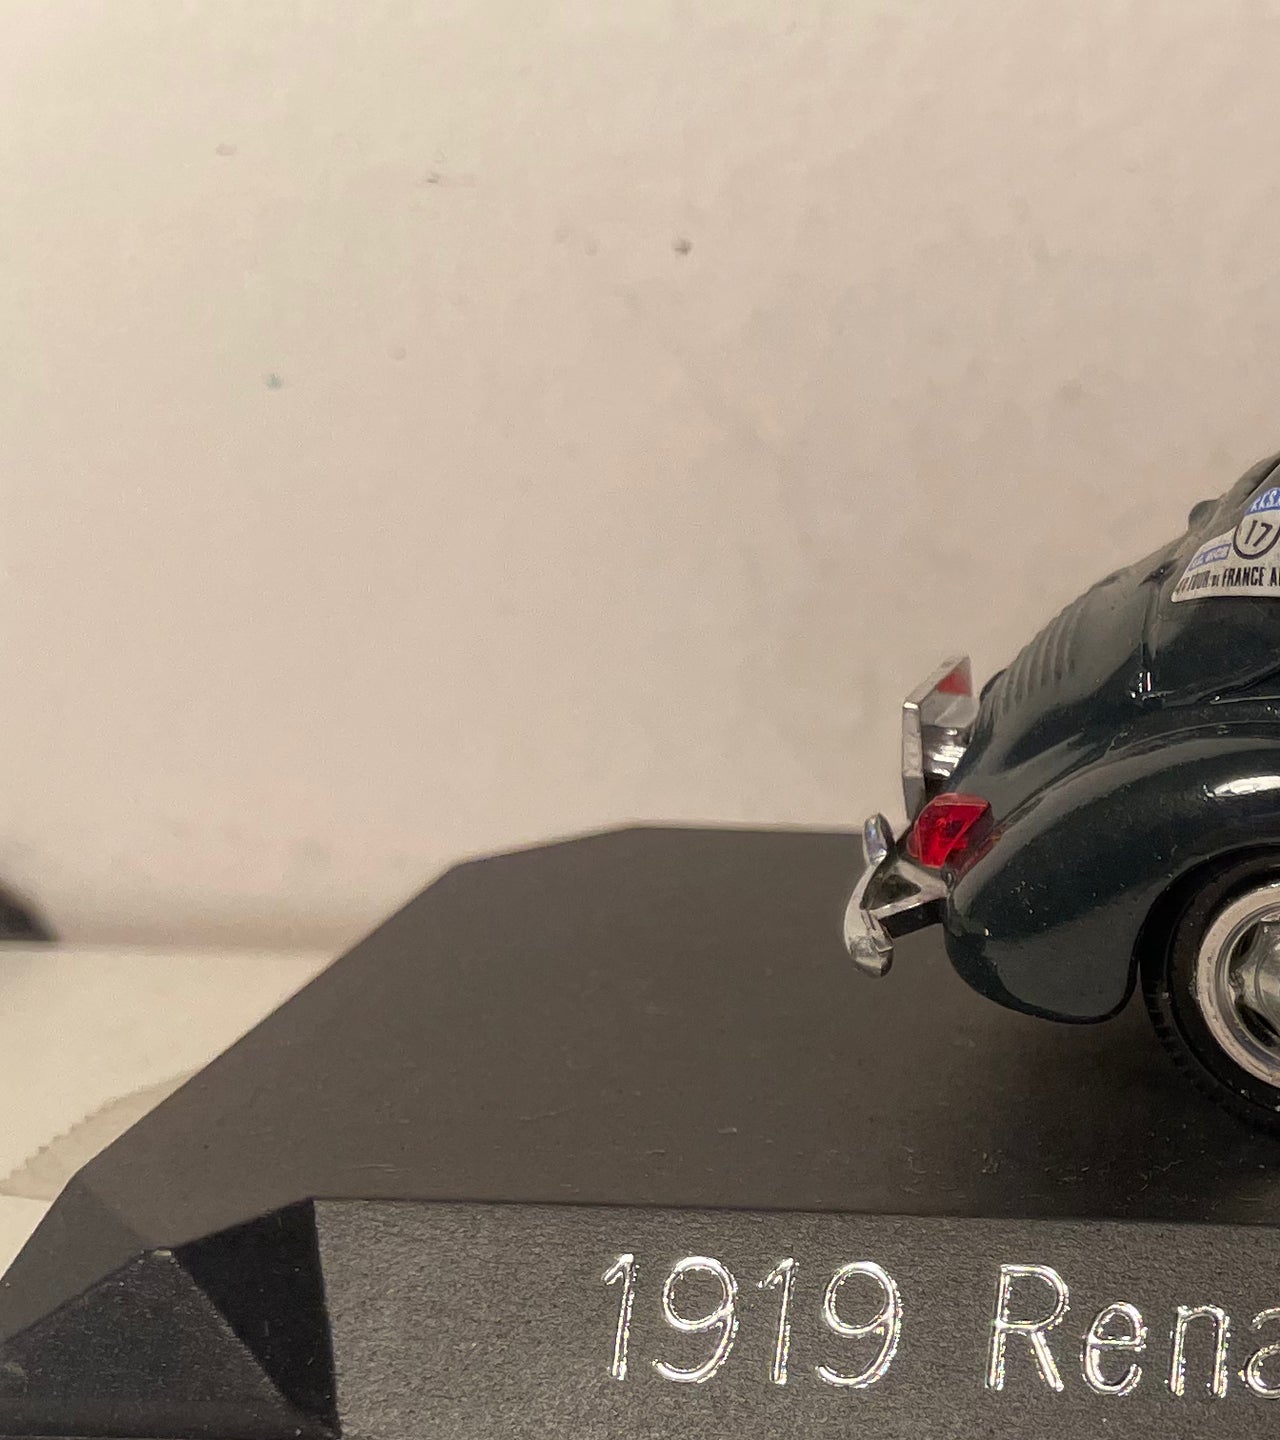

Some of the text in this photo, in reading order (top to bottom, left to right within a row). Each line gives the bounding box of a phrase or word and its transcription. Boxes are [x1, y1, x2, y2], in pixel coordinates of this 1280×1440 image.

[1244, 519, 1273, 547] 17
[1221, 566, 1264, 587] FRANCE
[601, 1253, 902, 1388] 1919
